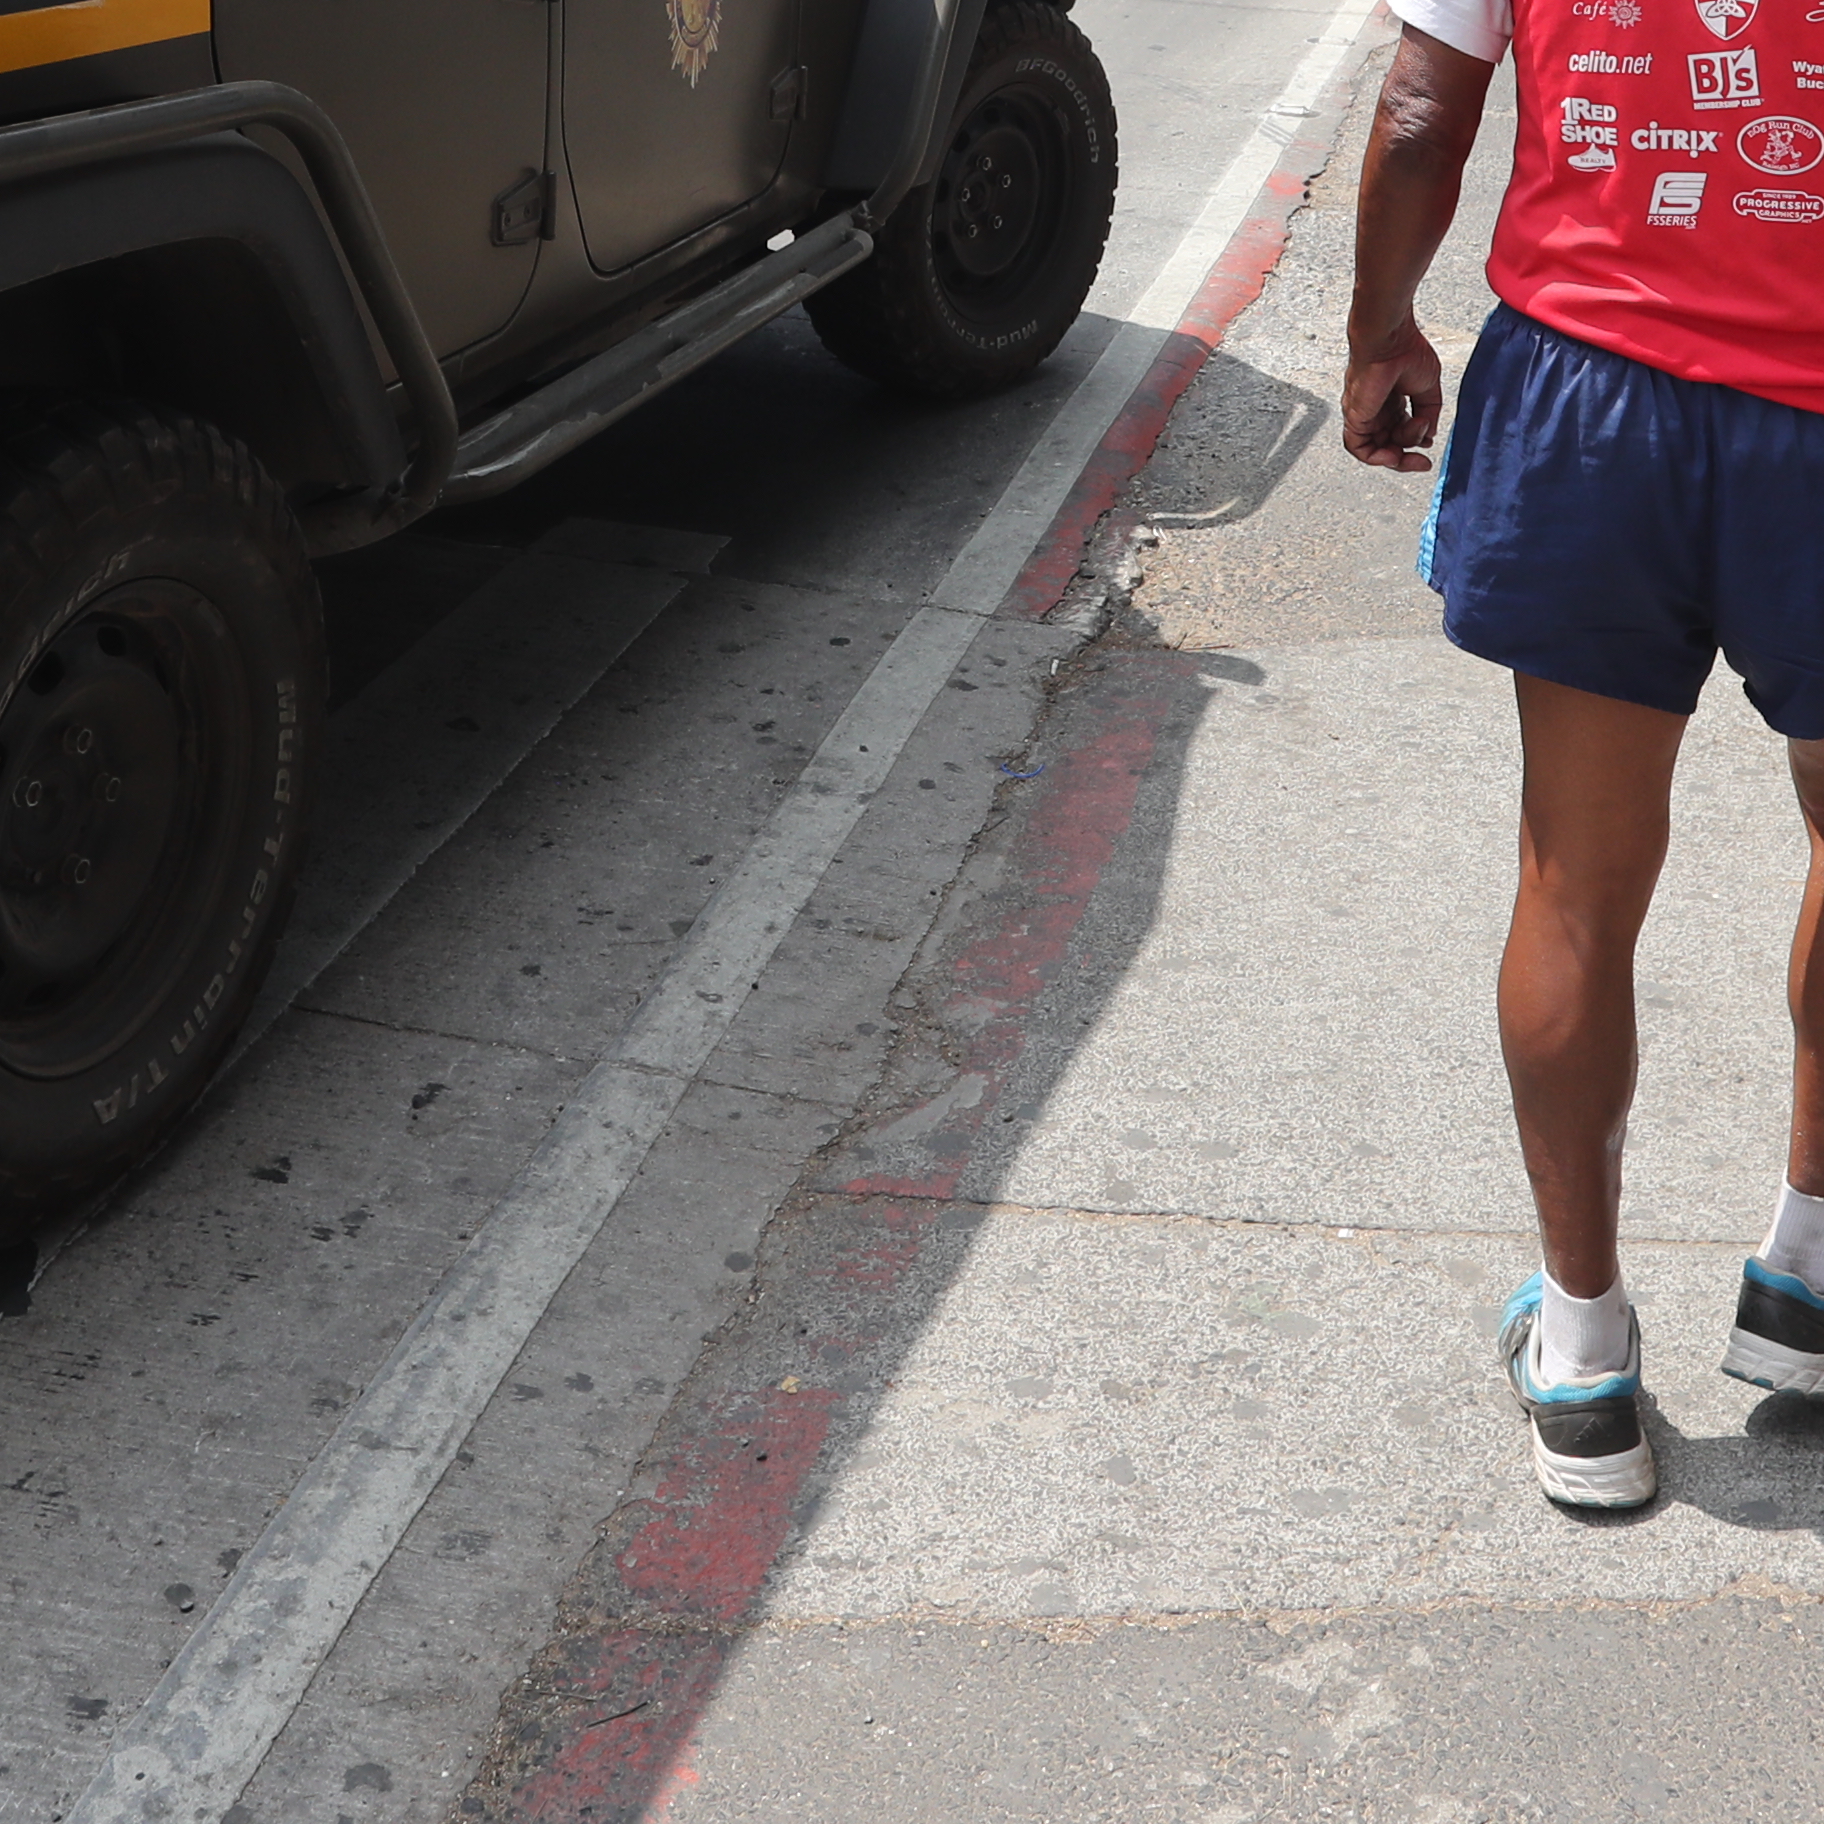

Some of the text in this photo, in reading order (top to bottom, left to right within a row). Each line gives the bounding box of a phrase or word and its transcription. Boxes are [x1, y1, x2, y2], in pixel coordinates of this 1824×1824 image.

[1572, 0, 1608, 21] Café
[1569, 50, 1653, 74] celito.net
[1561, 125, 1619, 146] SHOE
[1768, 121, 1790, 130] Run
[1792, 123, 1815, 139] Club
[1739, 198, 1820, 210] PROGRESSIVE
[1646, 215, 1698, 227] FSSERIES
[1758, 209, 1800, 219] GRAPHICS
